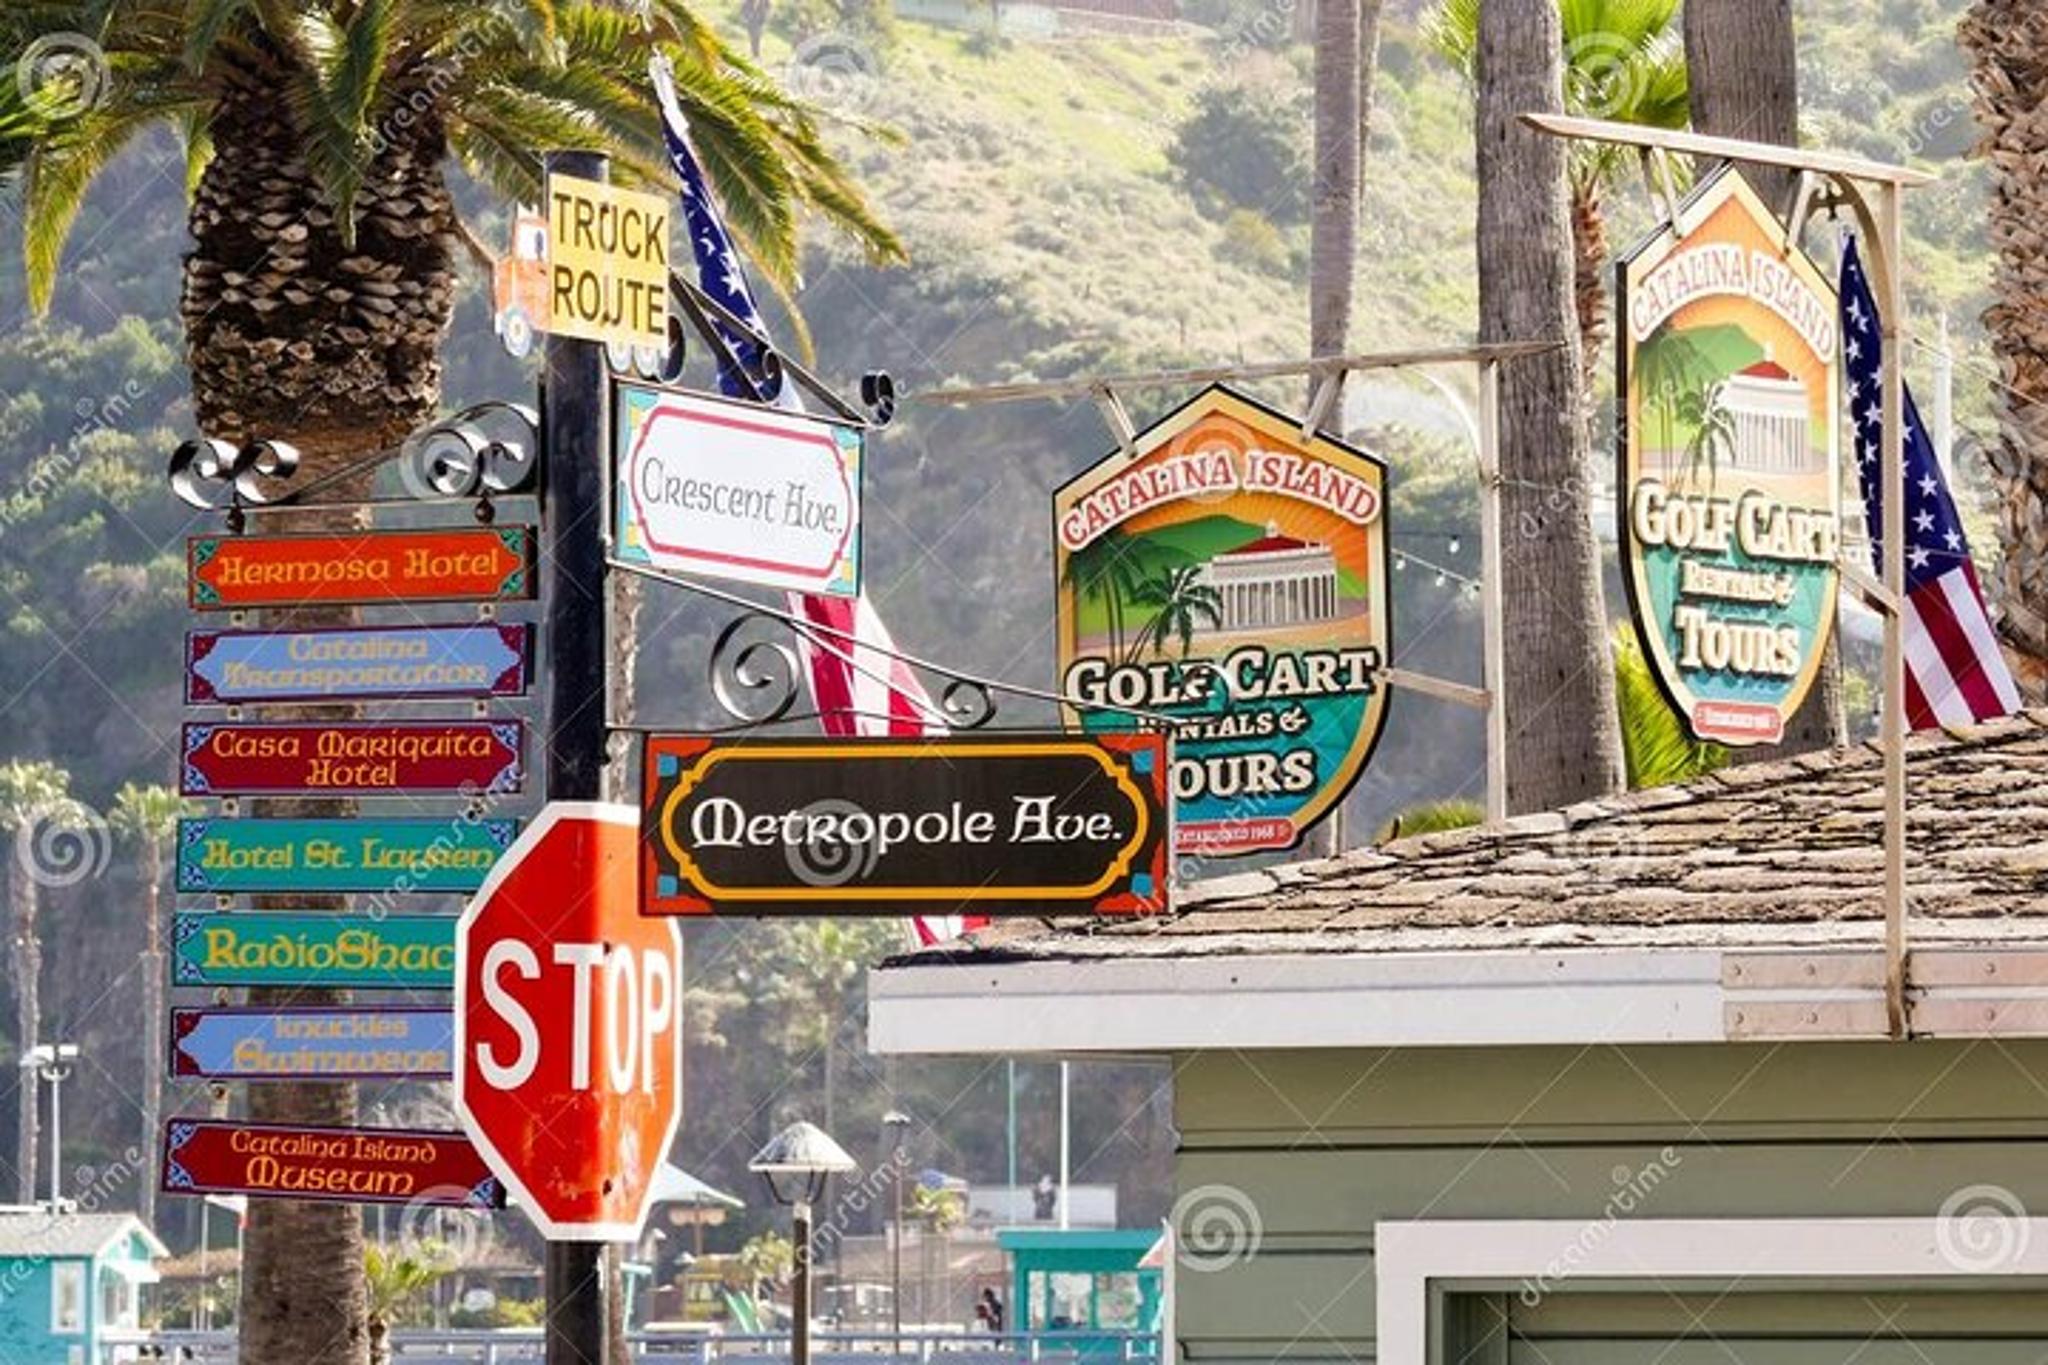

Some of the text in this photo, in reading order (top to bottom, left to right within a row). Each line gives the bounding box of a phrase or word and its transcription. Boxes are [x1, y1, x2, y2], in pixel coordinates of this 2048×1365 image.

[554, 193, 666, 265] TRUCK
[553, 264, 664, 335] ROUTE
[1632, 249, 1835, 356] CATALINA ISLAND
[642, 457, 843, 533] Crescent Ave.
[1061, 453, 1377, 546] CATALINA ISLAND
[1634, 480, 1840, 561] GOLF CART
[218, 548, 499, 586] Hermosa Hotel
[288, 635, 427, 663] Catalina
[1677, 605, 1799, 676] TOURS
[223, 661, 488, 693] Transportation
[1224, 649, 1376, 700] CART
[1279, 706, 1308, 732] &
[212, 729, 491, 764] Casa Mariquita
[305, 759, 397, 786] Hotel
[1173, 751, 1315, 798] OURS
[690, 794, 1123, 854] Metropole Ave.
[202, 838, 293, 869] Hotel
[304, 838, 350, 869] St.
[203, 928, 456, 970] RadioShac
[475, 938, 673, 1096] STOP
[230, 1130, 437, 1163] Catalina Island
[246, 1155, 414, 1194] Museum
